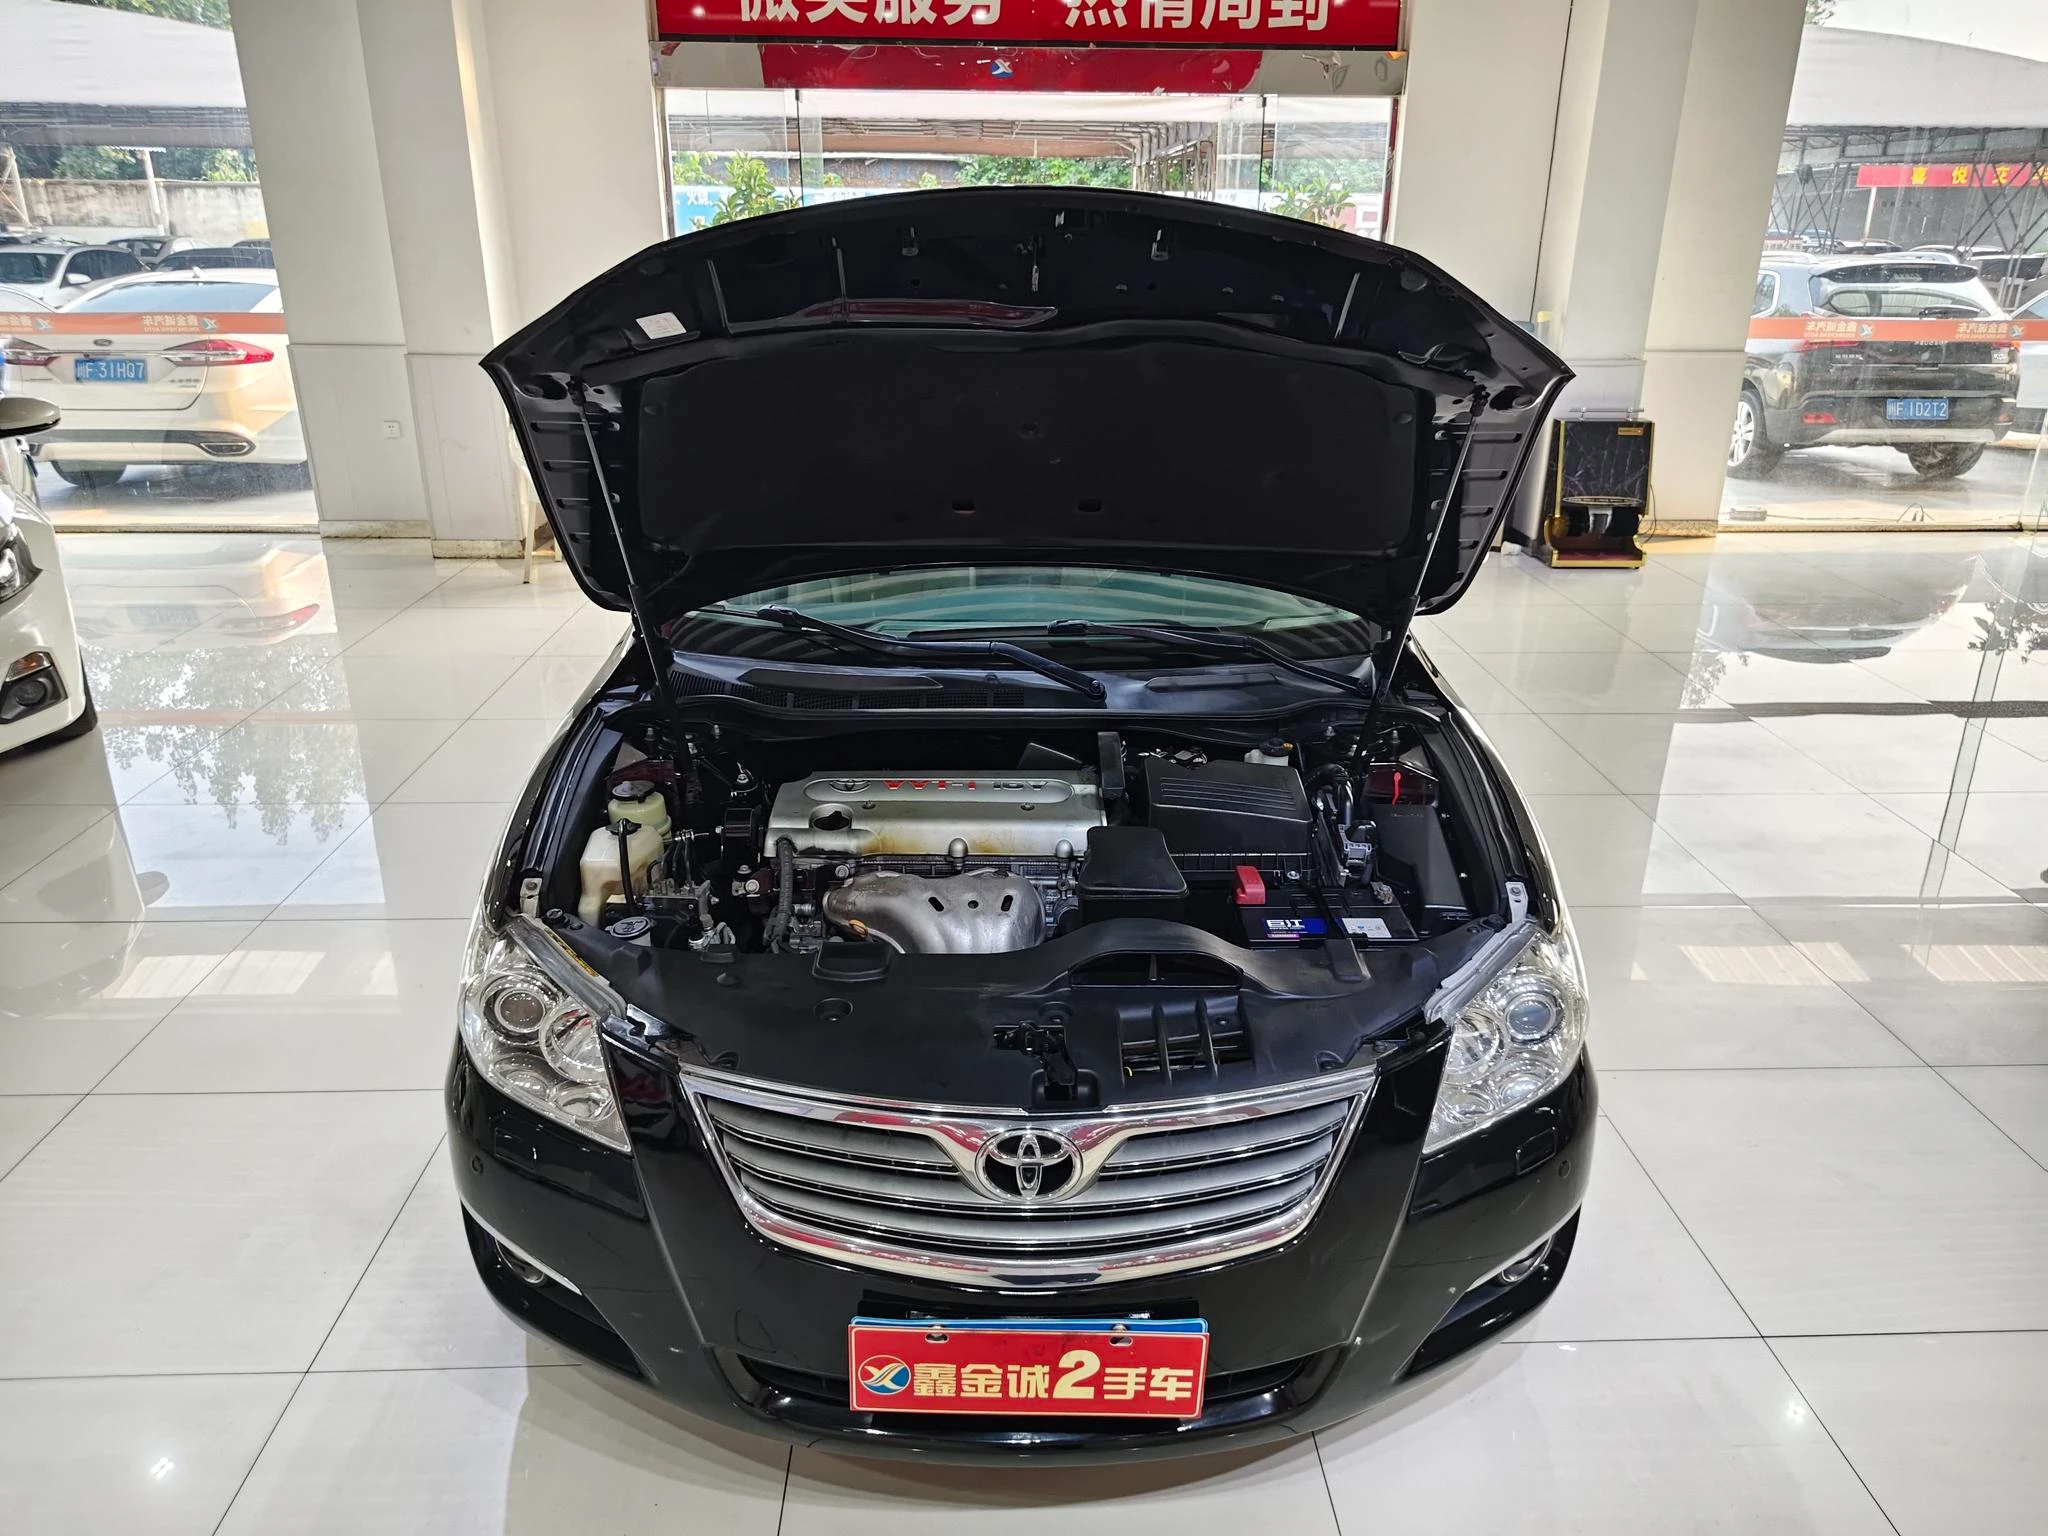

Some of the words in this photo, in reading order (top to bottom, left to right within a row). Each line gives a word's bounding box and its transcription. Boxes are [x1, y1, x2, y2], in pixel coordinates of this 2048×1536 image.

[913, 1350, 1192, 1400] 鑫金诚2手车
